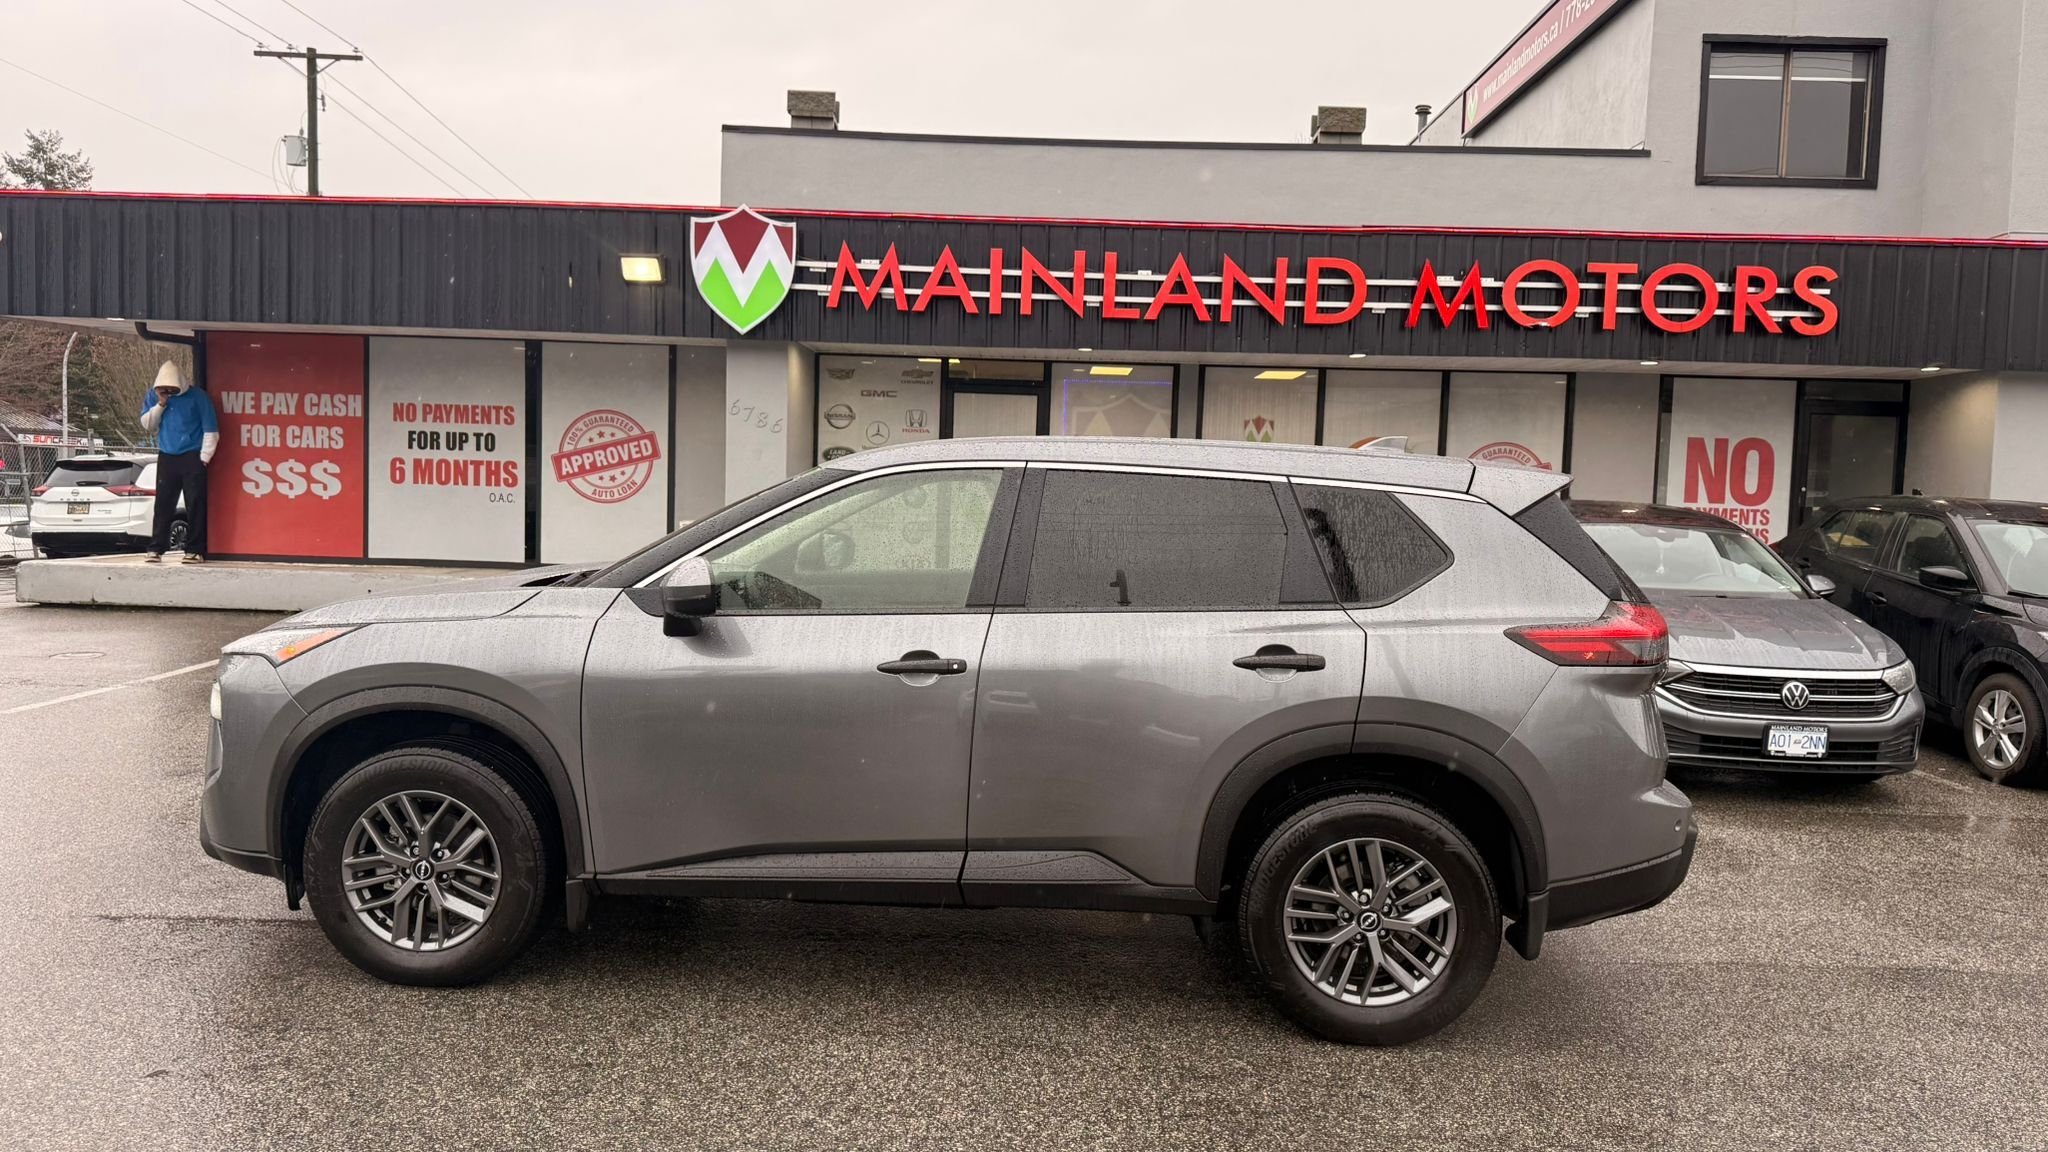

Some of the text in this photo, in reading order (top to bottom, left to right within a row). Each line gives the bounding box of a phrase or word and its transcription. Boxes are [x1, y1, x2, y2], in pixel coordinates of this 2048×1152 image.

[1483, 21, 1559, 102] www.mainlandmotors.ca
[826, 239, 1839, 336] MAINLAND MOTORS
[221, 391, 362, 417] WE PAY CASH
[860, 390, 898, 398] GMC
[393, 402, 515, 425] NO PAYMENTS
[729, 400, 783, 434] 6786
[240, 424, 344, 449] FOR CARS
[408, 430, 496, 452] FOR UP TO
[567, 415, 634, 446] 100% GUARANTEED
[561, 438, 653, 476] APPROVED
[1482, 447, 1531, 464] GUARANTEED
[241, 458, 342, 500] $$$
[390, 457, 518, 488] 6 MONTHS
[1683, 436, 1775, 507] NO
[489, 492, 516, 503] O.A.C.
[592, 479, 638, 498] AUTO LOAN
